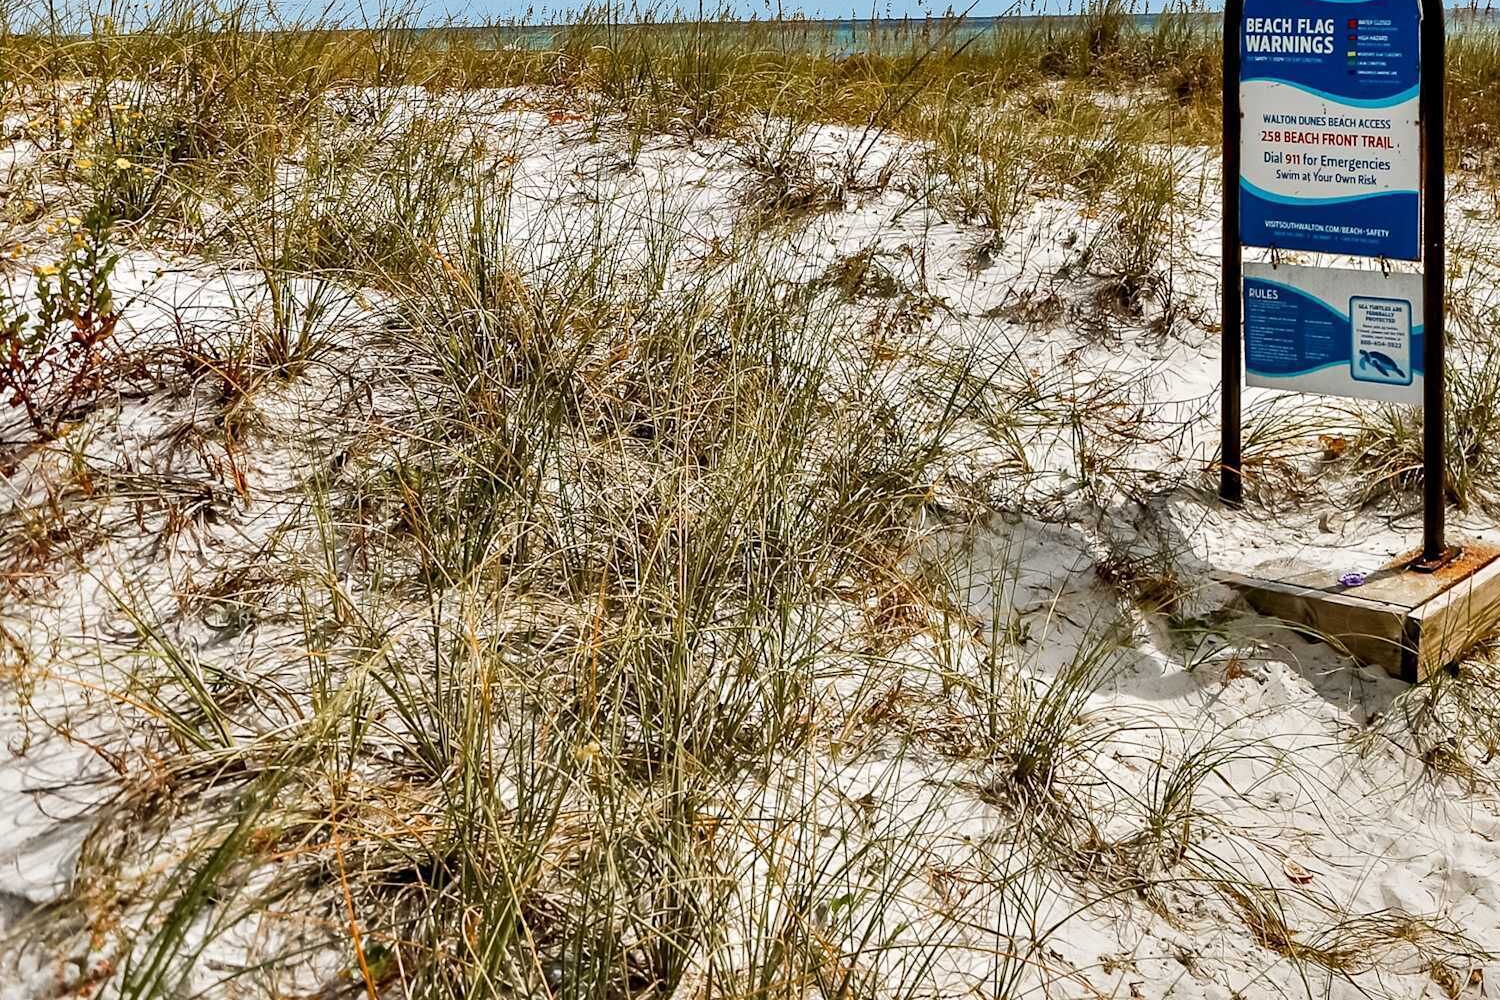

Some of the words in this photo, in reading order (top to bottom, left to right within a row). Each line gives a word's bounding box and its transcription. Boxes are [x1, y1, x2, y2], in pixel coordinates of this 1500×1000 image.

[1246, 18, 1292, 33] BEACH
[1298, 19, 1334, 34] FLAG
[1246, 35, 1334, 54] WARNINGS
[1263, 114, 1297, 125] WALTON
[1299, 116, 1326, 126] DUNES
[1328, 117, 1356, 127] BEACH
[1358, 119, 1391, 129] ACCESS
[1261, 131, 1280, 142] 258
[1284, 132, 1318, 144] BEACH
[1322, 133, 1358, 146] FRONT
[1361, 135, 1394, 149] TRAIL
[1264, 152, 1282, 164] Dial
[1285, 154, 1300, 164] 911
[1303, 153, 1318, 165] for
[1321, 155, 1391, 172] Emergencies
[1276, 170, 1299, 180] Swim
[1302, 173, 1311, 182] at
[1313, 171, 1333, 182] Your
[1335, 174, 1356, 184] Own
[1358, 175, 1377, 185] Risk
[1248, 288, 1279, 300] RULES
